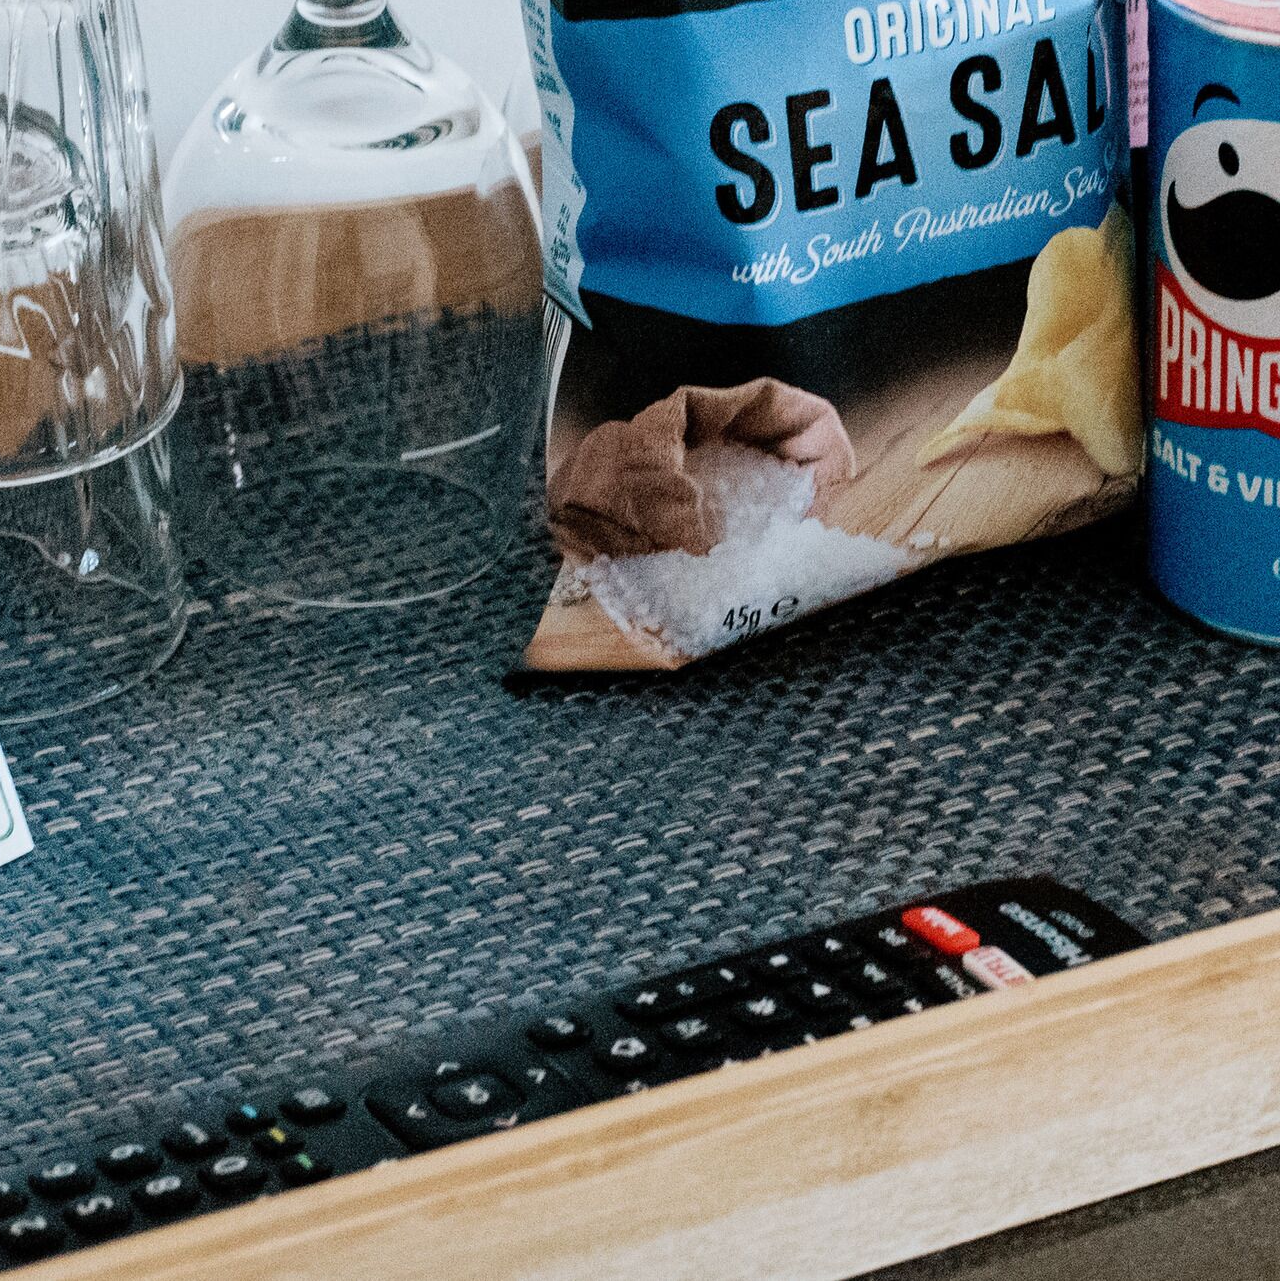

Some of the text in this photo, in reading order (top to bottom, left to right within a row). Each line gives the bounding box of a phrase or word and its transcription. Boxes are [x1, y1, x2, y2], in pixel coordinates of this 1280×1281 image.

[709, 76, 918, 229] SEA
[949, 25, 1106, 170] SAL
[732, 242, 793, 285] with
[791, 220, 884, 284] South
[894, 185, 1051, 253] Australian
[1207, 464, 1230, 495] &
